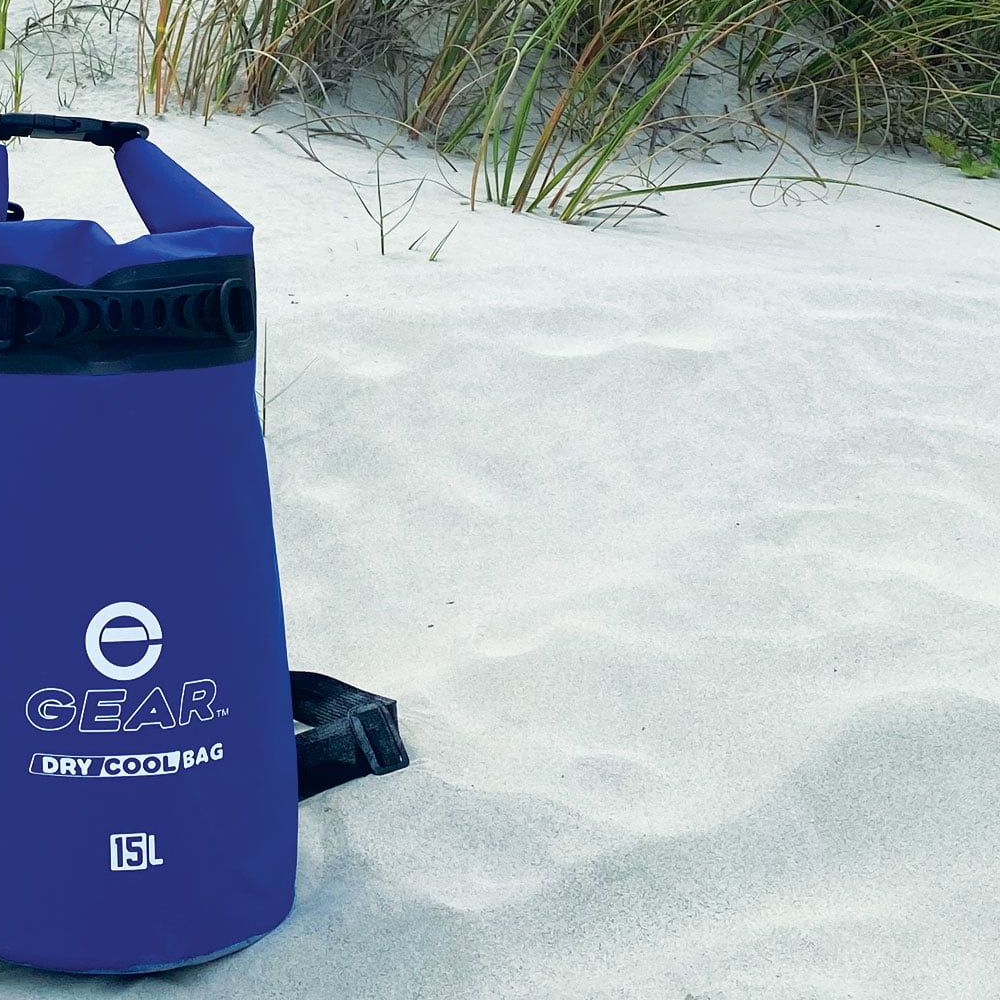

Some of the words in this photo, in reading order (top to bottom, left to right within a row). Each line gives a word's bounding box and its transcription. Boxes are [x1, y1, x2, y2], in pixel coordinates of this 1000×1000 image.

[42, 756, 93, 776] DRY
[104, 755, 178, 776] COOL
[182, 743, 223, 769] BAG
[111, 833, 163, 870] 15L
